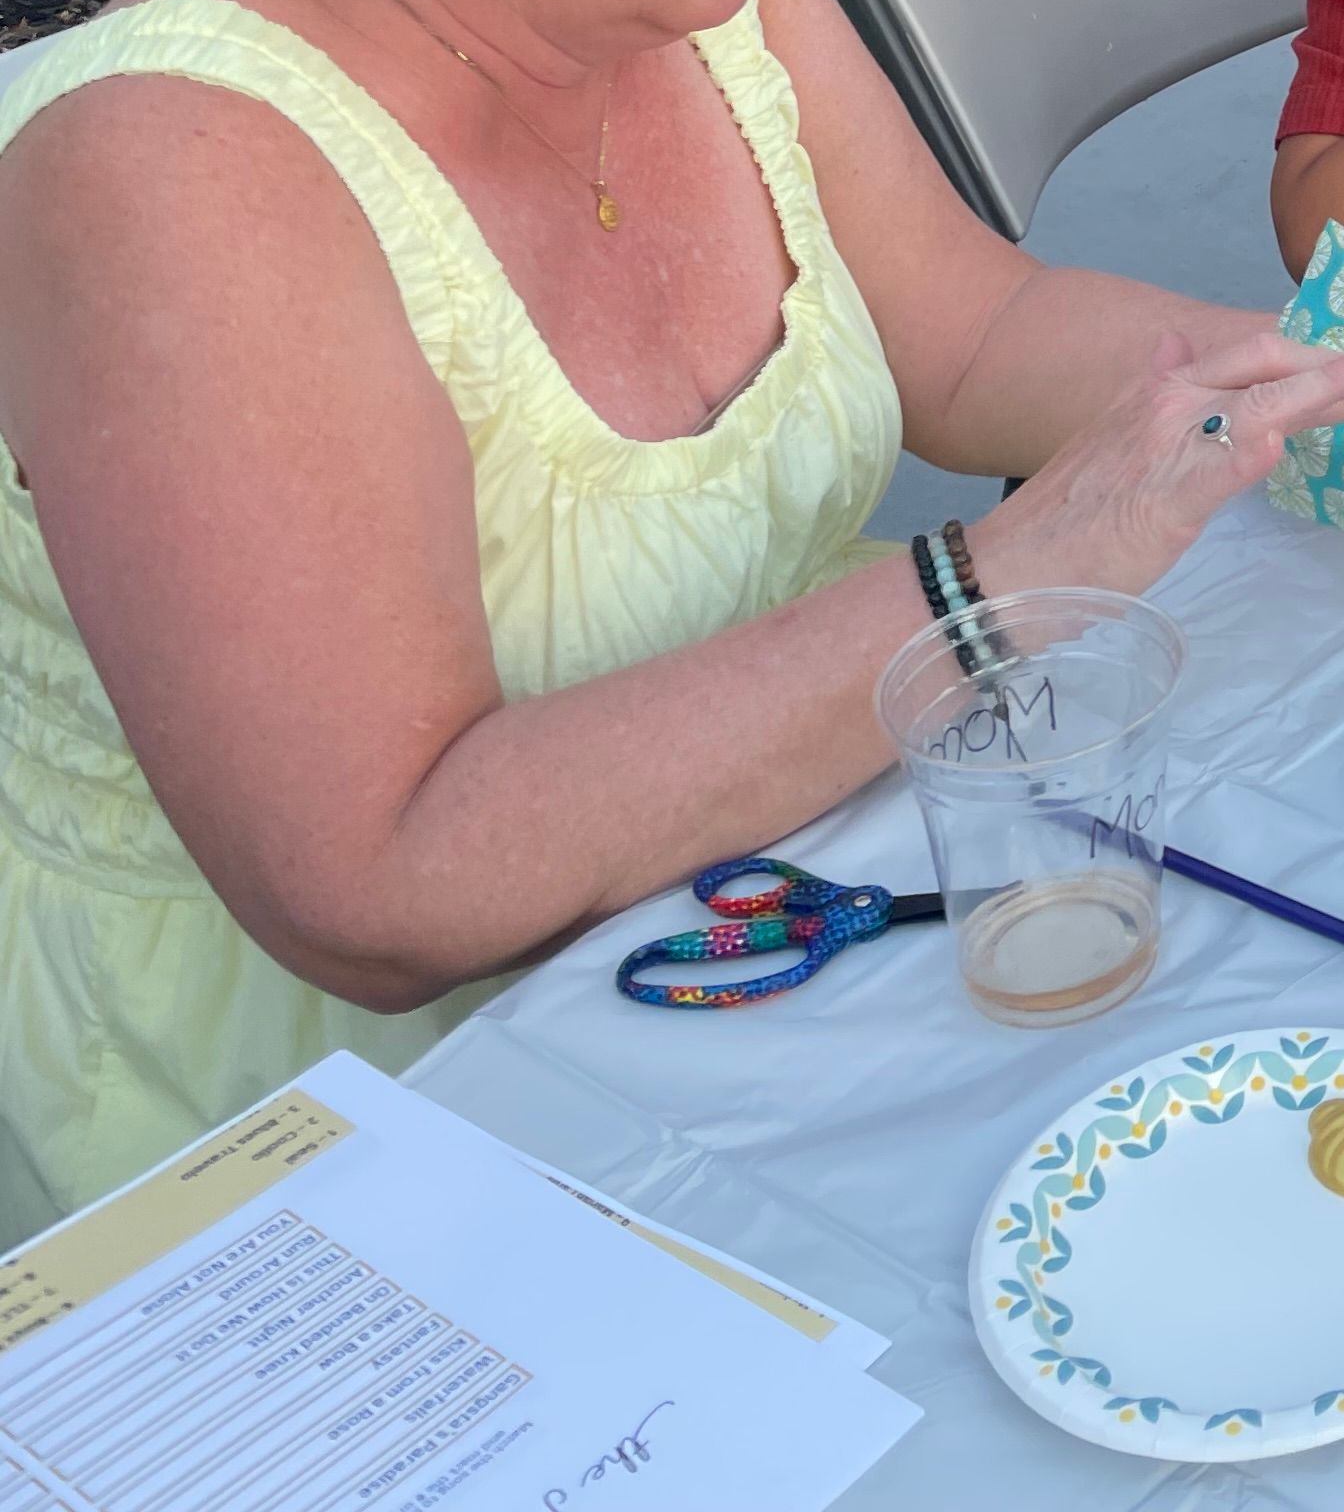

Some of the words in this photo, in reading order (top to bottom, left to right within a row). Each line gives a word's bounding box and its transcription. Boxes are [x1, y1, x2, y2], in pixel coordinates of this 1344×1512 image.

[256, 1211, 292, 1240] You
[225, 1238, 256, 1261] Are
[280, 1233, 319, 1258] Run
[302, 1246, 342, 1275] This
[194, 1260, 227, 1282] Not
[218, 1256, 281, 1300] Around
[141, 1280, 190, 1315] Alone
[246, 1286, 288, 1314] How
[296, 1267, 363, 1315] Another
[363, 1280, 390, 1303] On
[217, 1314, 248, 1333] We
[241, 1308, 295, 1347] Night
[299, 1302, 366, 1350] Bended
[369, 1297, 415, 1332] Take
[190, 1332, 219, 1350] Do
[353, 1329, 371, 1342] a
[367, 1319, 440, 1370] Fantasy
[429, 1337, 467, 1364] Kiss
[254, 1347, 300, 1379] Knee
[317, 1341, 358, 1370] Bow
[384, 1364, 431, 1398] from
[403, 1355, 494, 1422] Waterfalls
[368, 1396, 385, 1408] a
[327, 1407, 374, 1440] Rose
[580, 1400, 675, 1489] the
[358, 1439, 438, 1498] Paradise
